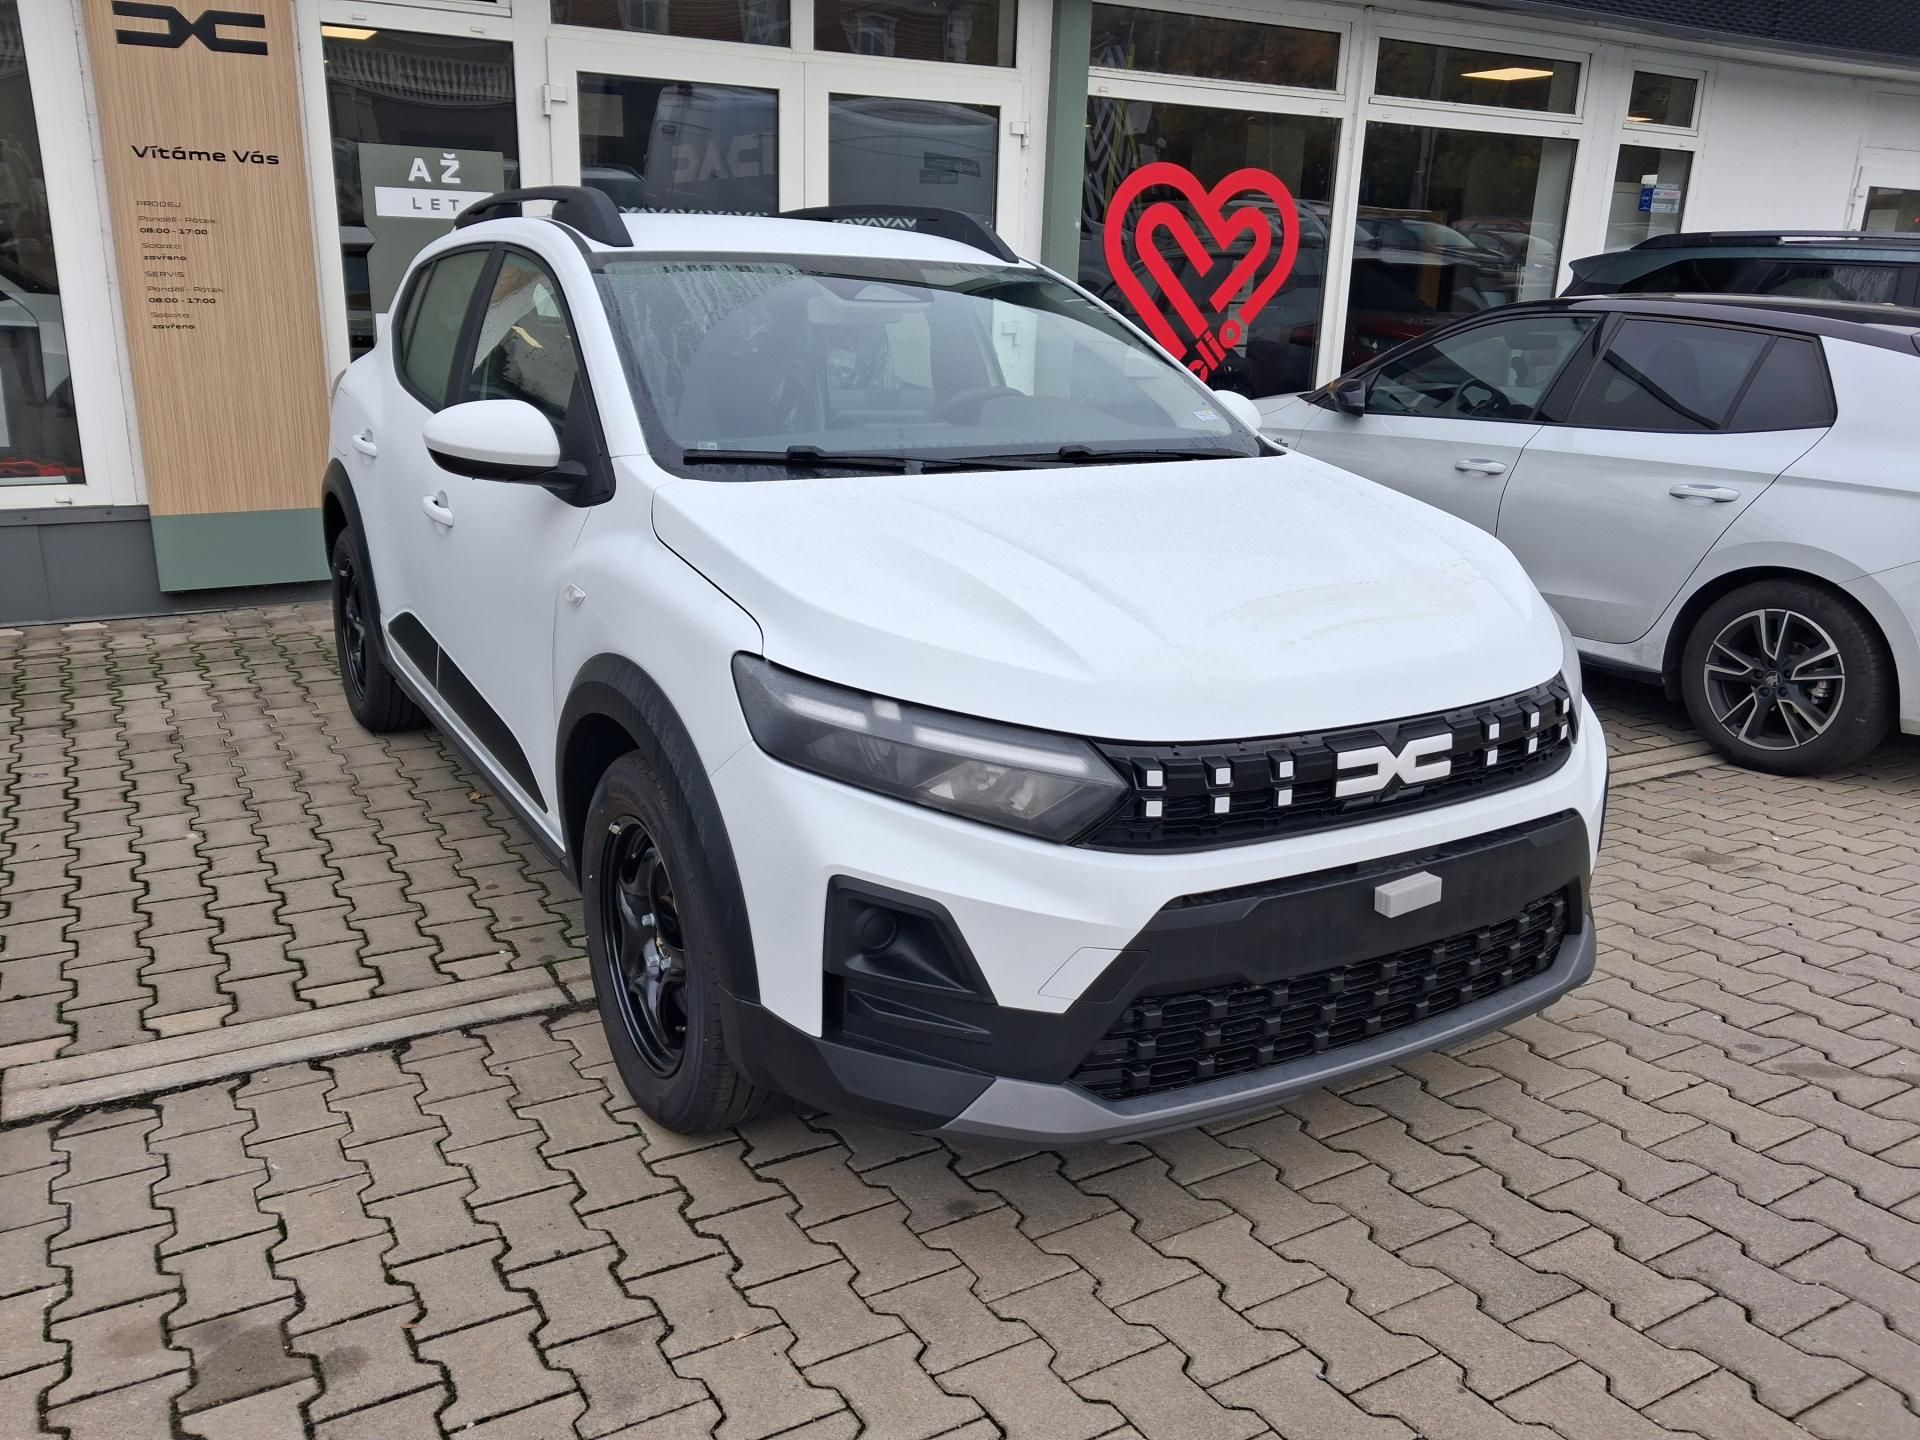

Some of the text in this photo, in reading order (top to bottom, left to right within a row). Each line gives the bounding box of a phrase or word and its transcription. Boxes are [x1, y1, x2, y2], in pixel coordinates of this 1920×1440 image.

[130, 144, 280, 165] Vítáme Vás
[408, 153, 461, 184] AŽ
[136, 200, 182, 208] PRODEJ
[412, 197, 460, 212] LET
[144, 270, 185, 278] SERVIS
[152, 322, 195, 330] zavřeno
